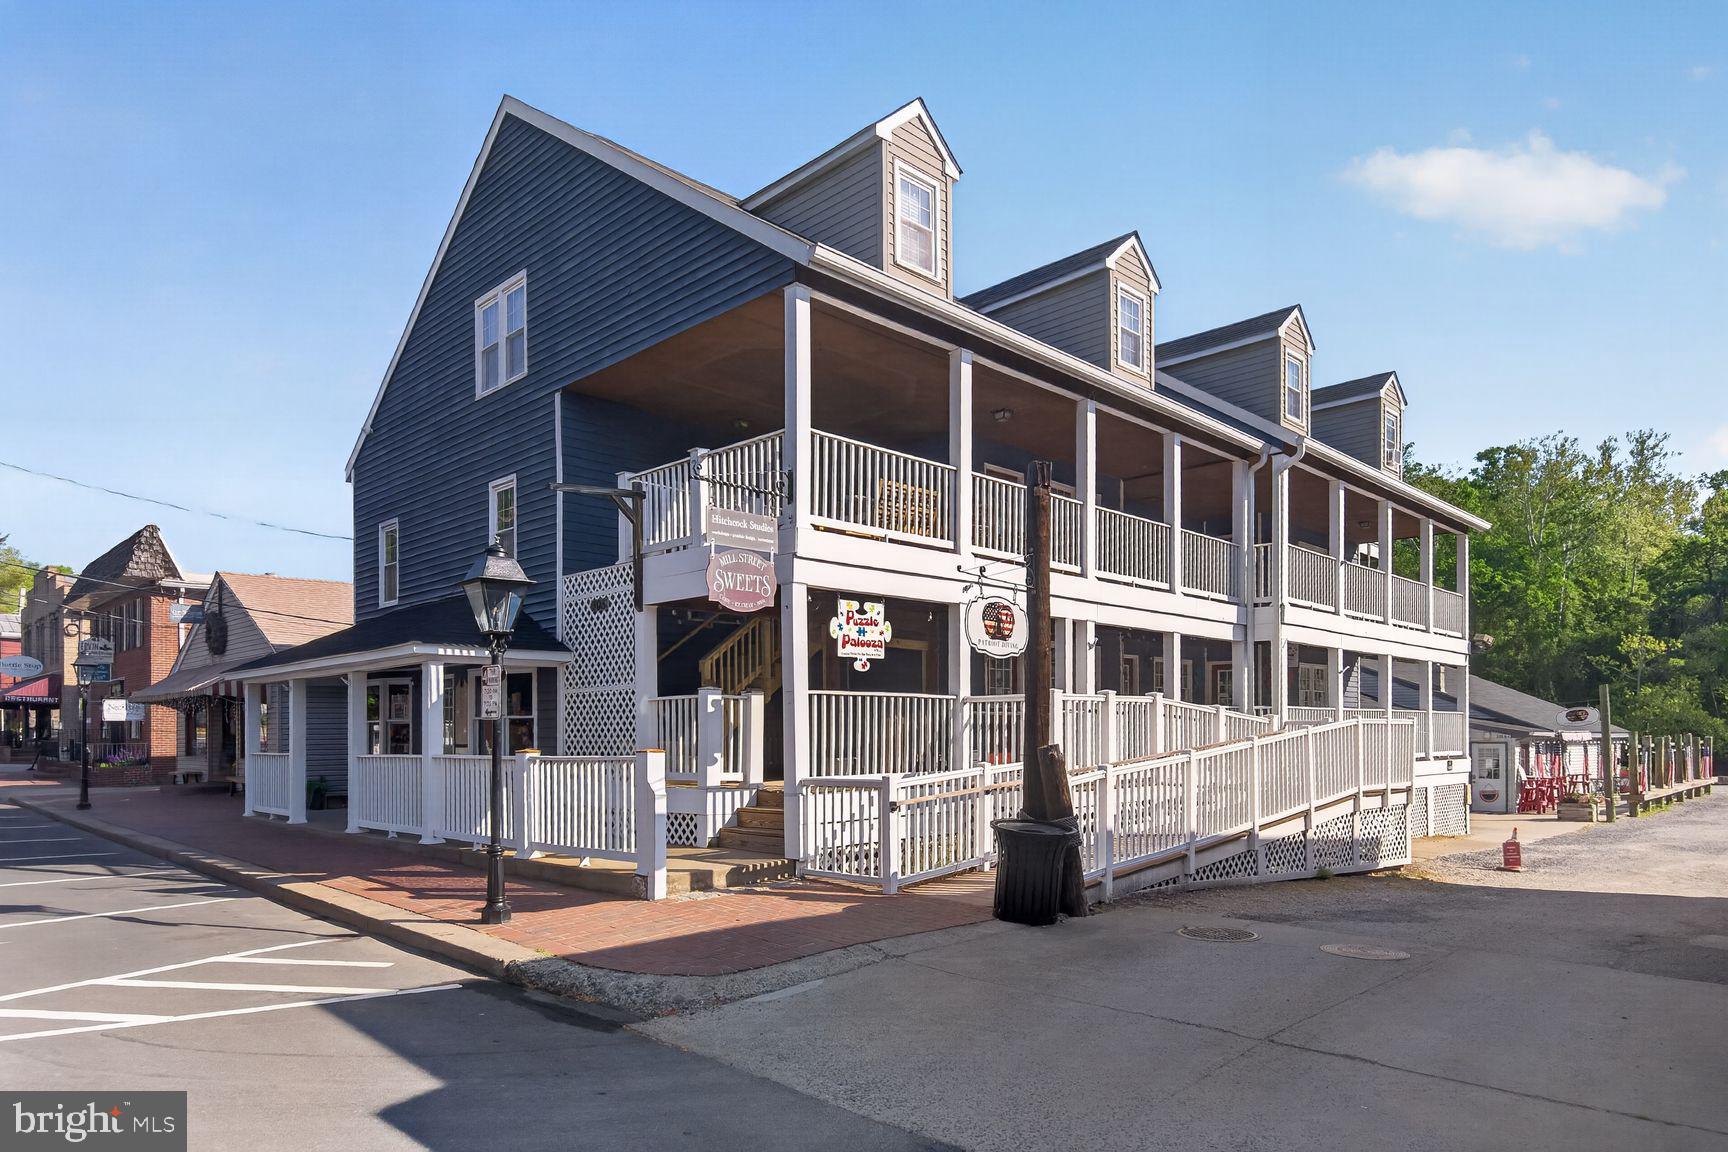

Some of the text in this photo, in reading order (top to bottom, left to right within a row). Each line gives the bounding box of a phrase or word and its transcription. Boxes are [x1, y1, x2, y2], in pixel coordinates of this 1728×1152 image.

[712, 515, 774, 533] Hitchcock Studios
[719, 553, 767, 571] MILL STREET
[713, 568, 771, 597] SWEETS
[845, 609, 879, 627] Puzzle
[841, 633, 883, 649] Palooza
